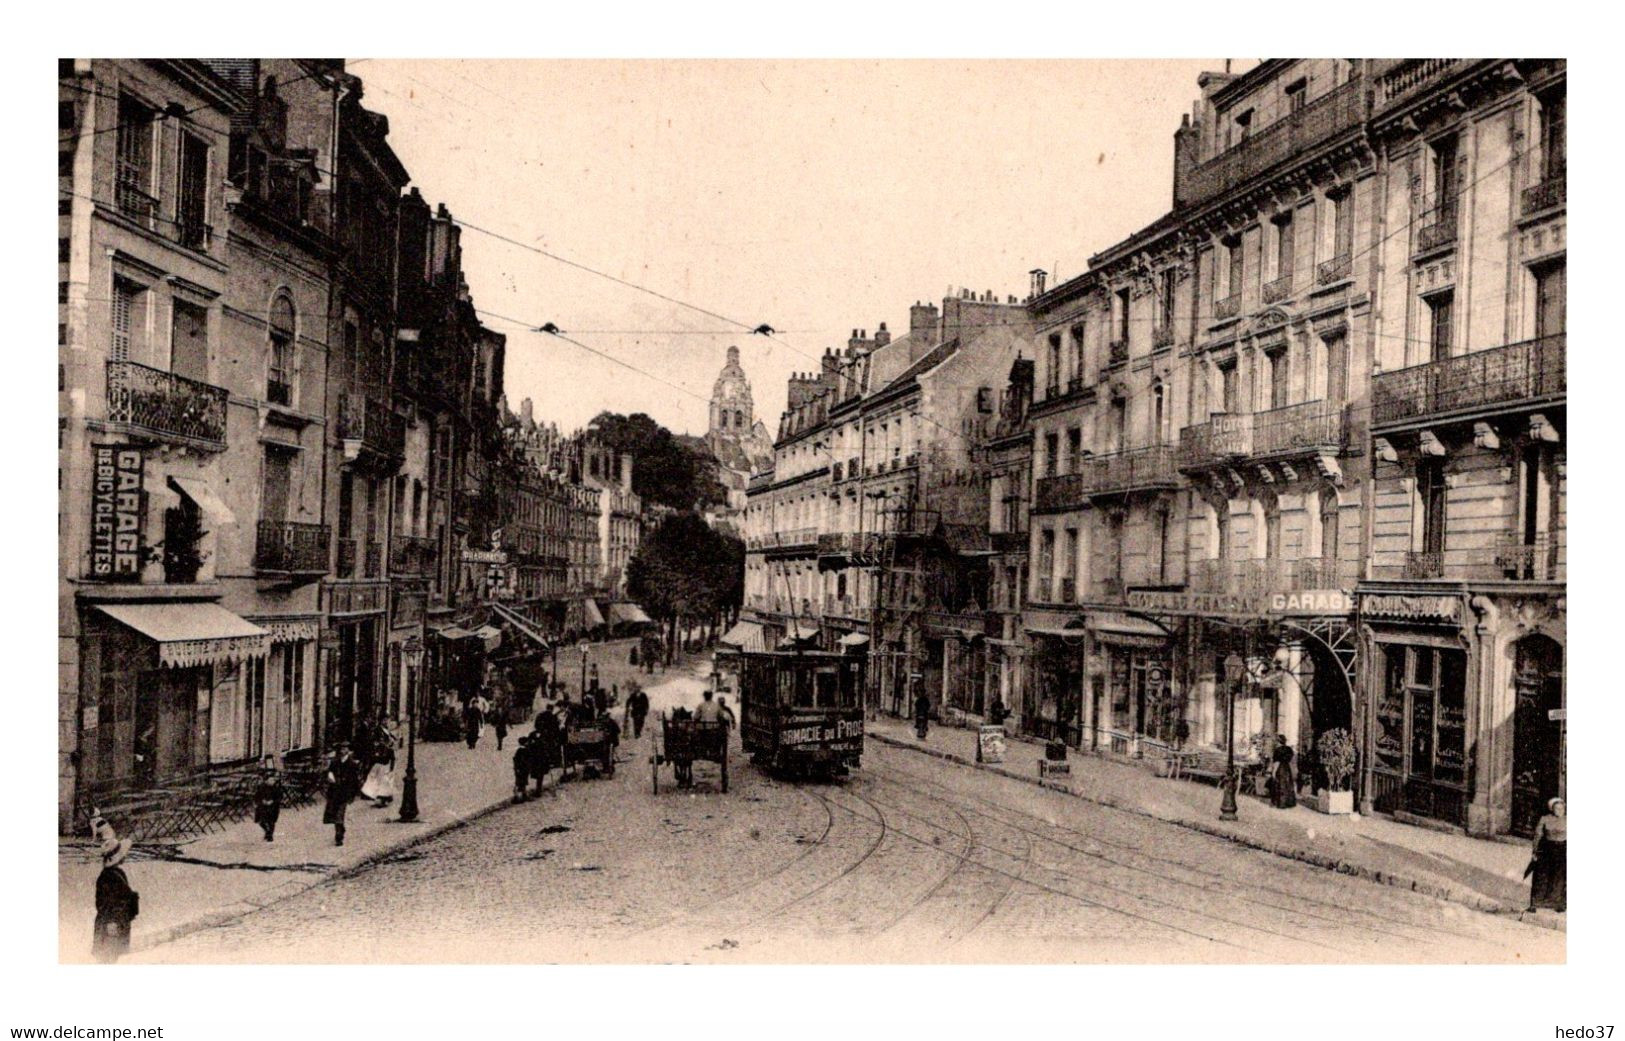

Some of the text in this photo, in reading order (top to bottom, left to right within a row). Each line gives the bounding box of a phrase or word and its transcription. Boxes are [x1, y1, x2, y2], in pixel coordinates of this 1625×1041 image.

[95, 466, 114, 574] BICYCLETTES
[115, 450, 140, 573] GARAGE
[1272, 594, 1357, 610] GARAGE
